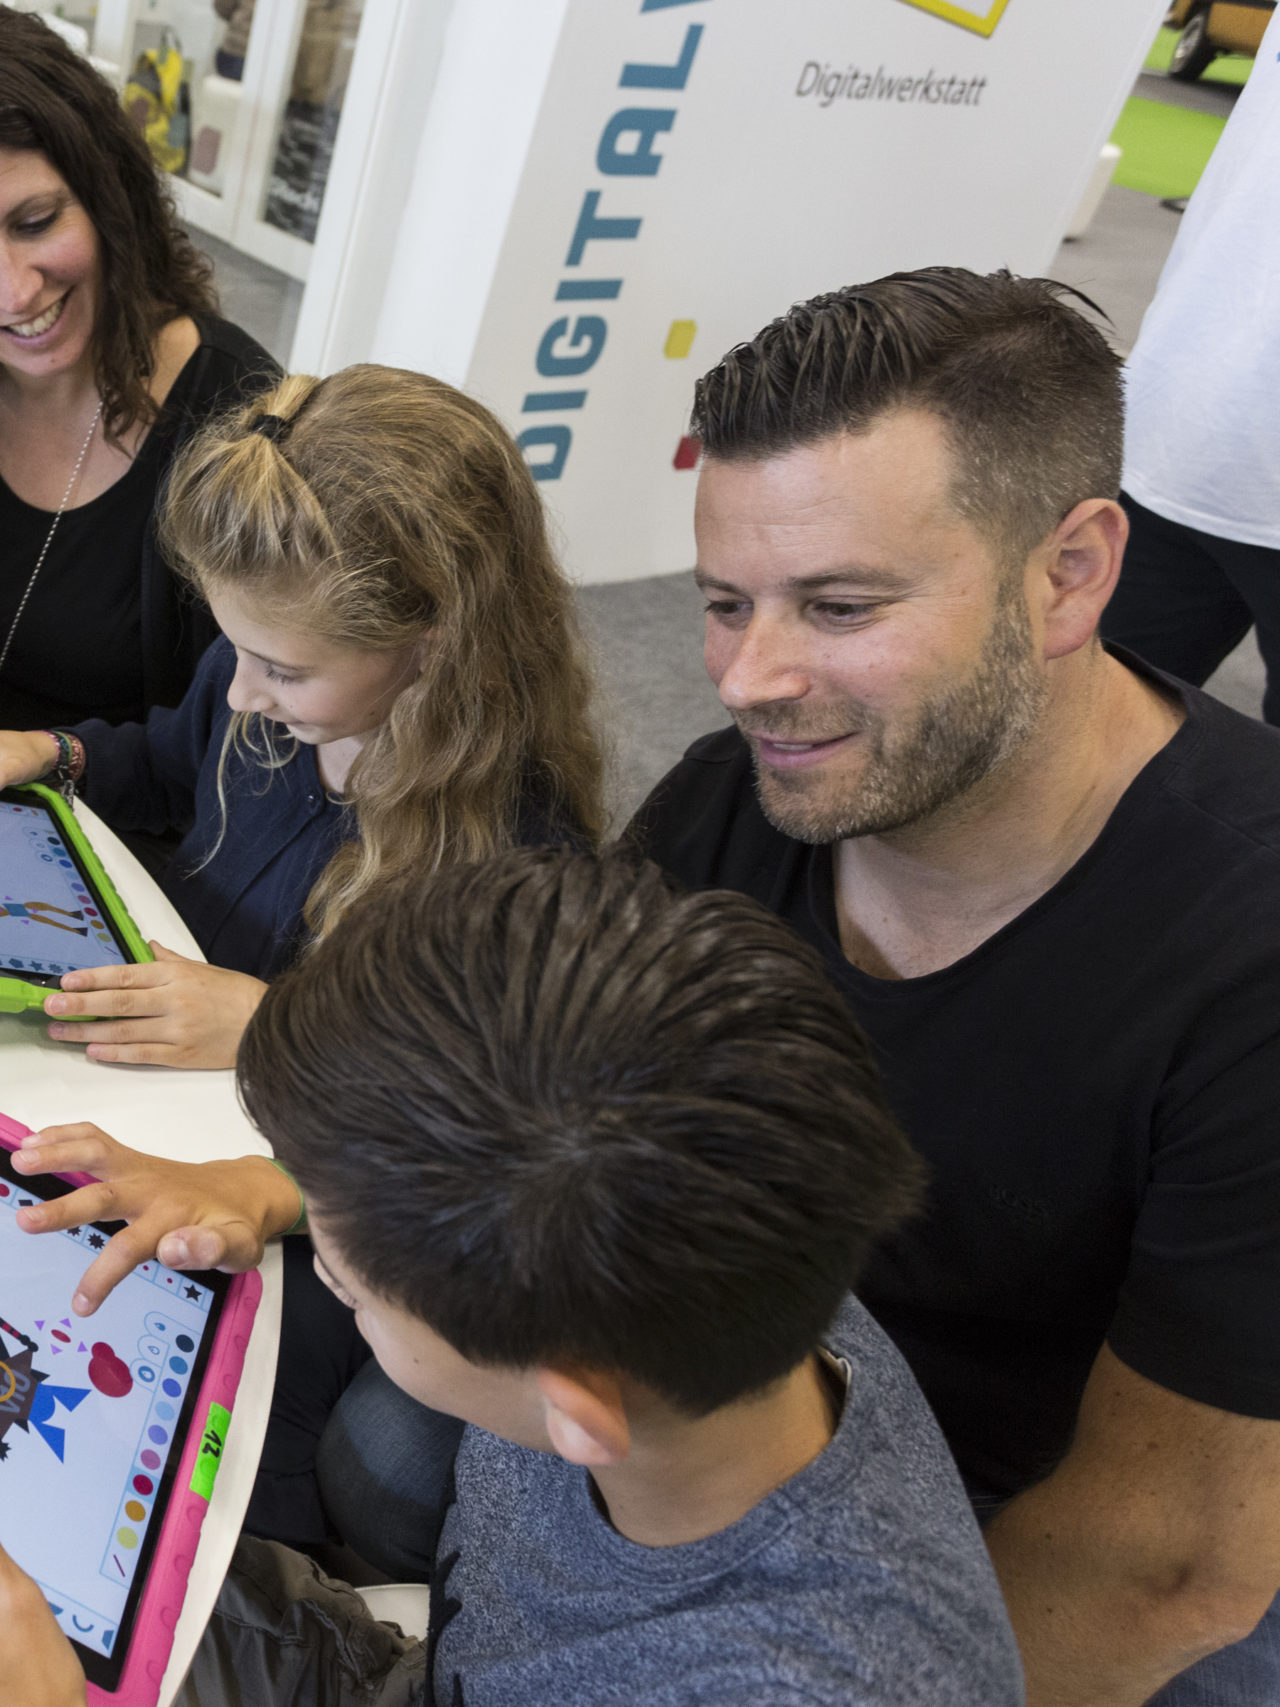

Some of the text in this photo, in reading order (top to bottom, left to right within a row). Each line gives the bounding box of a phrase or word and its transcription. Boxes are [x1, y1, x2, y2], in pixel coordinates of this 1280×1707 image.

[795, 60, 988, 109] Digitalwerkstatt
[516, 0, 710, 483] DIGITAL
[202, 1429, 223, 1459] 12
